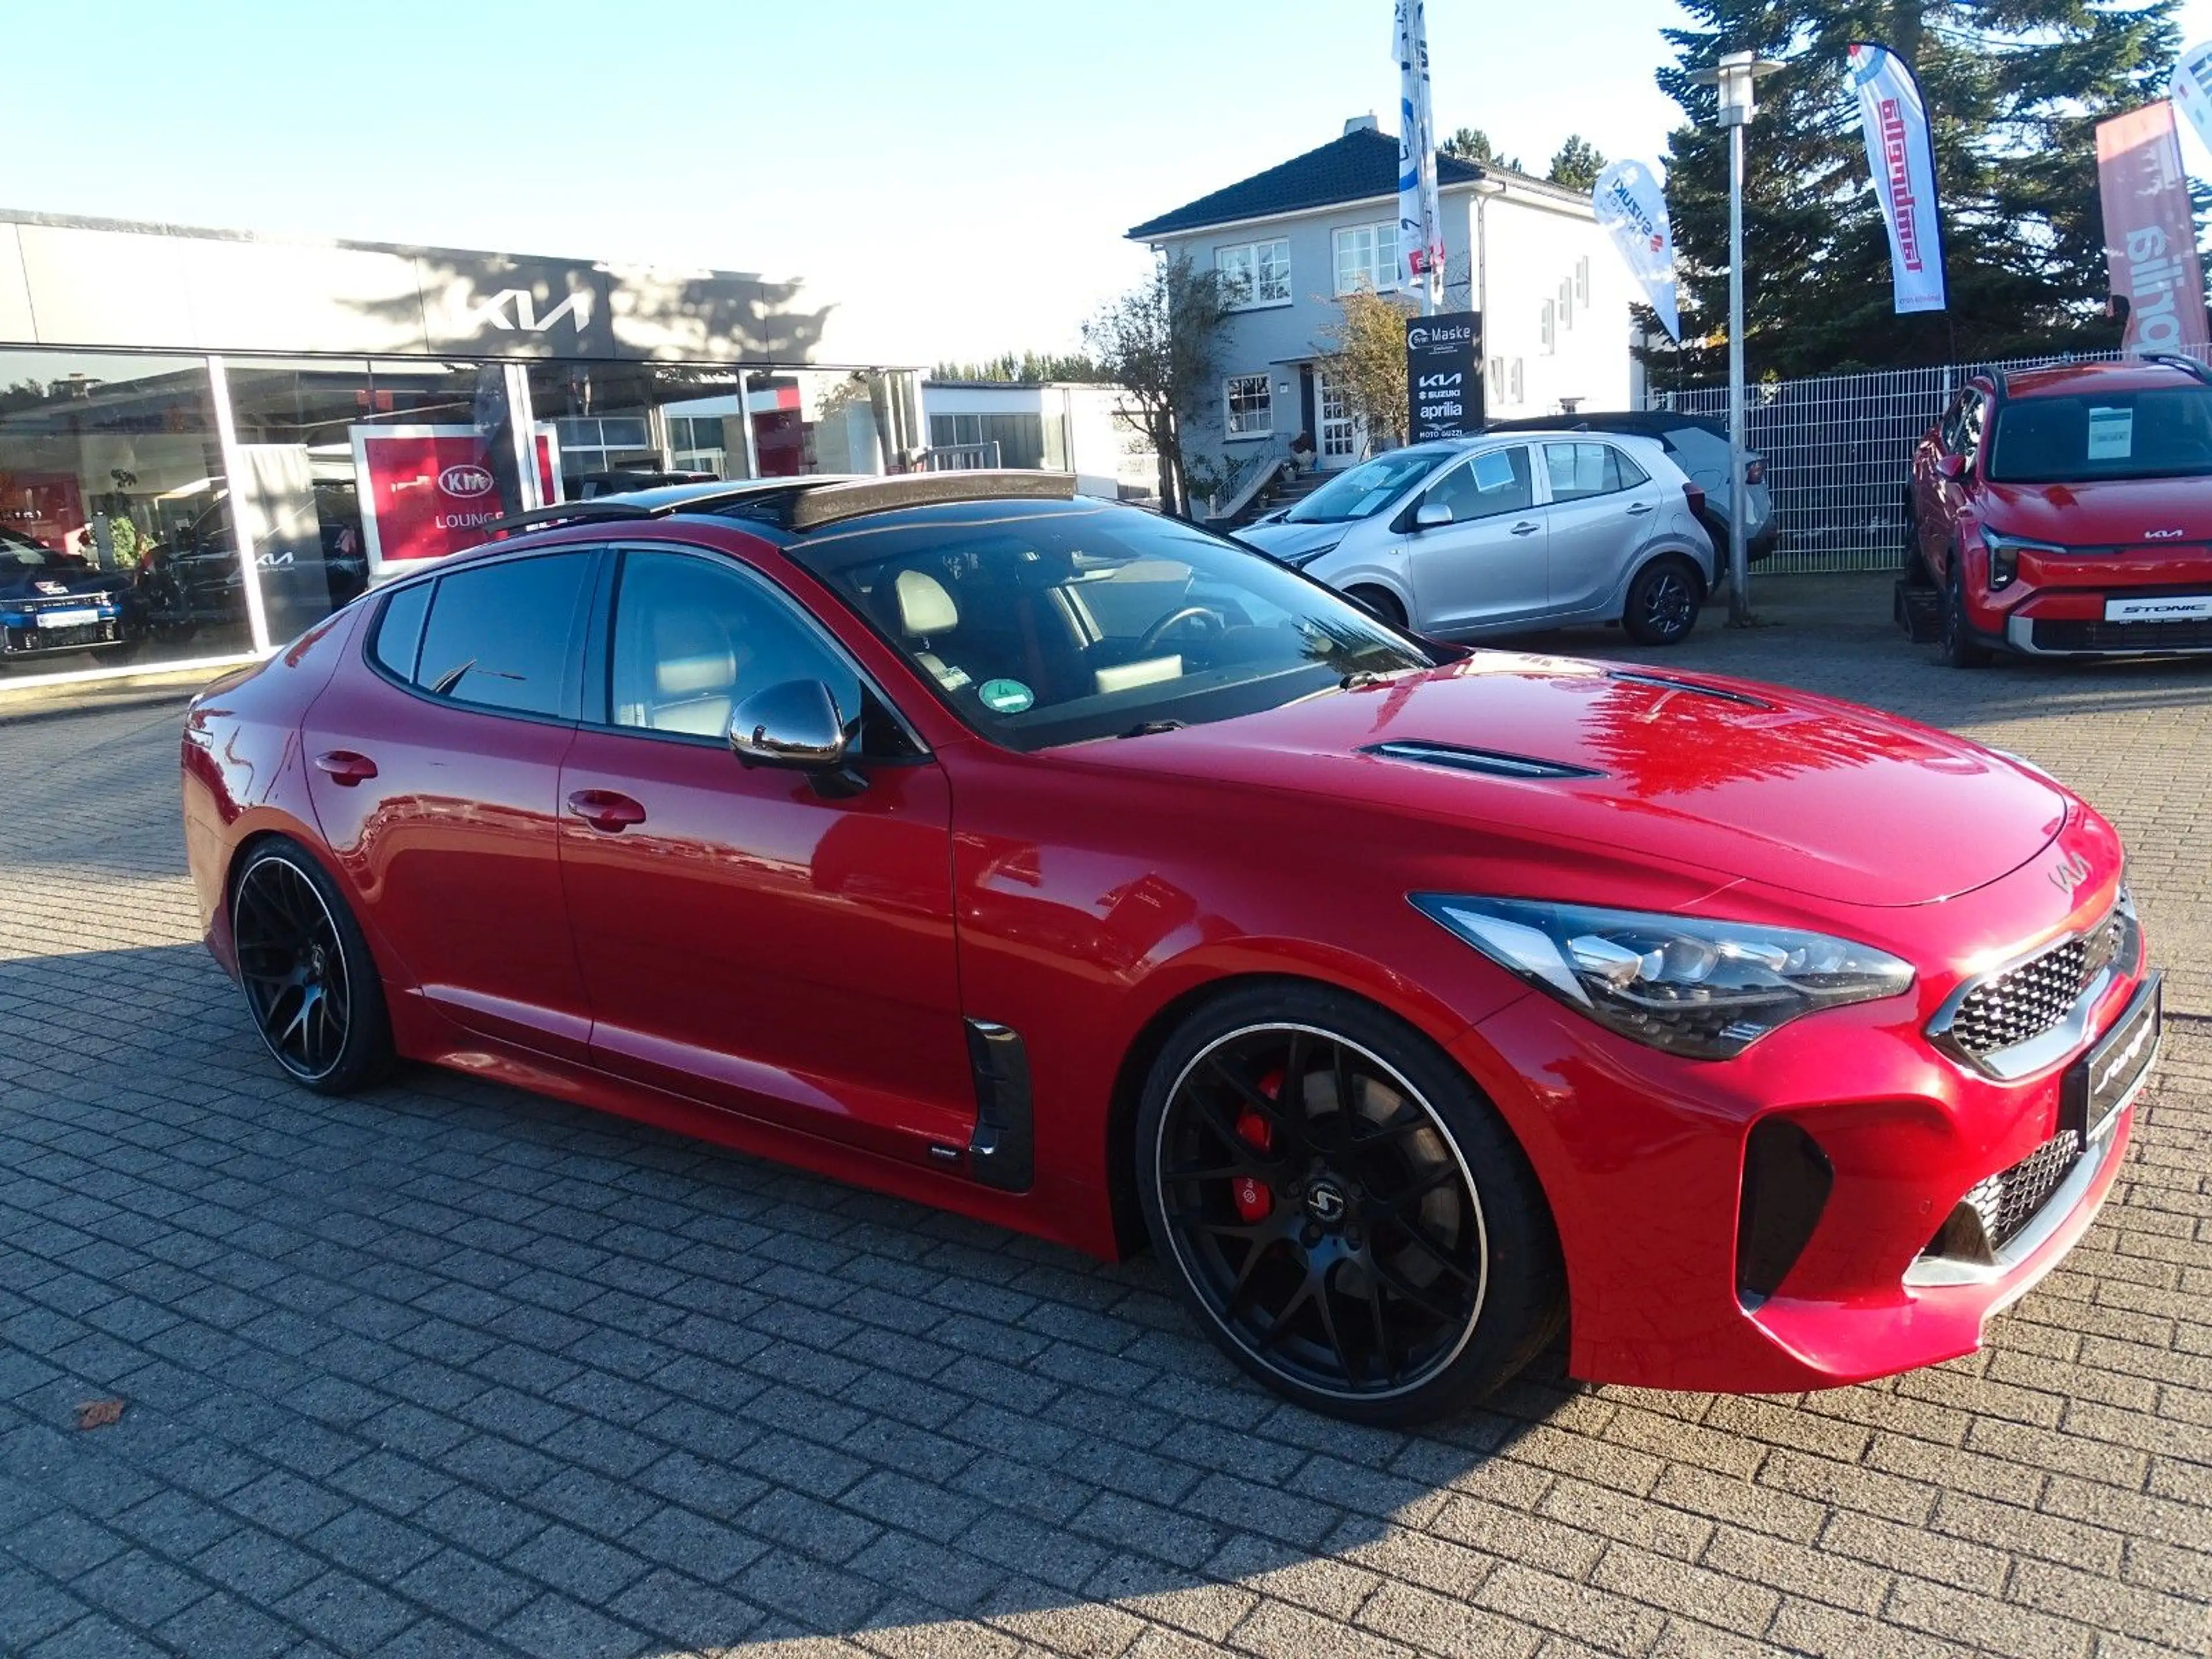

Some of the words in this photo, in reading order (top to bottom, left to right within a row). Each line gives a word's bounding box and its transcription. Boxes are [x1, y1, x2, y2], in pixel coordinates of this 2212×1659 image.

[1431, 325, 1471, 341] Maske
[1428, 389, 1461, 399] SUZUKI
[1420, 401, 1463, 419] aprilia
[2122, 604, 2207, 613] STONIC
